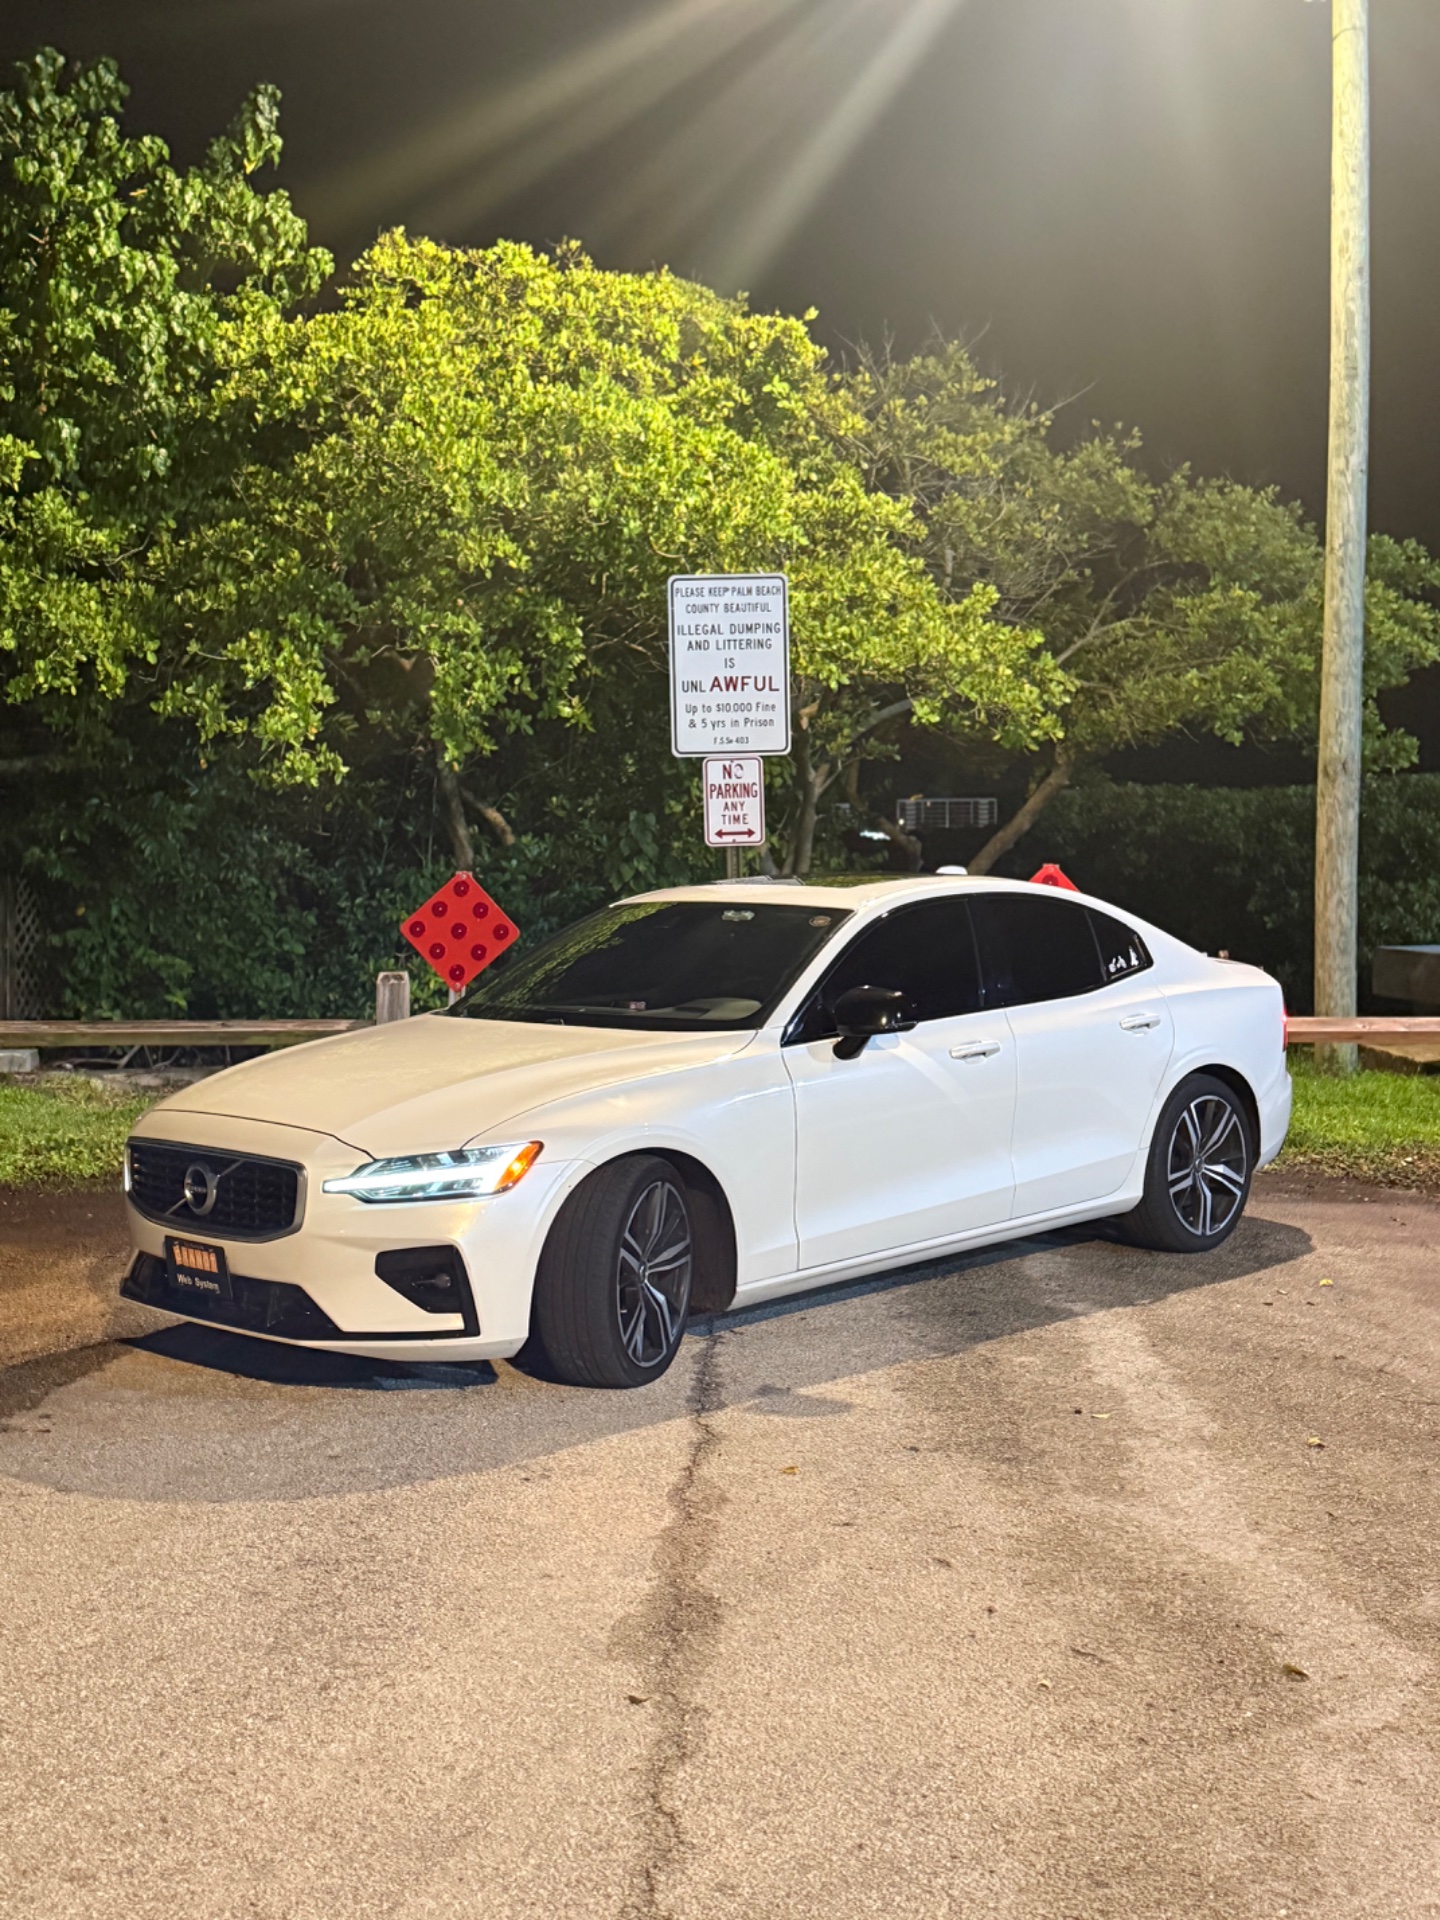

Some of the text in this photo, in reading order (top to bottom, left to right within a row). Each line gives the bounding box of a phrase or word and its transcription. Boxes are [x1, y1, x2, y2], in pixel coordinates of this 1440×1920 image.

[675, 585, 781, 598] PLEASE KEEP PALM BEACH
[685, 602, 772, 614] COUNTY BEAUTIFUL
[677, 622, 781, 636] ILLEGAL DUMPING
[687, 638, 772, 651] AND LITTERING
[724, 657, 735, 669] IS
[685, 703, 698, 716] Up
[702, 703, 712, 713] to
[755, 701, 776, 712] Fine
[688, 717, 775, 731] & 5 yrs in Prison
[722, 763, 744, 780] NO
[709, 782, 758, 800] PARKING
[723, 801, 745, 812] ANY
[721, 813, 749, 825] TIME
